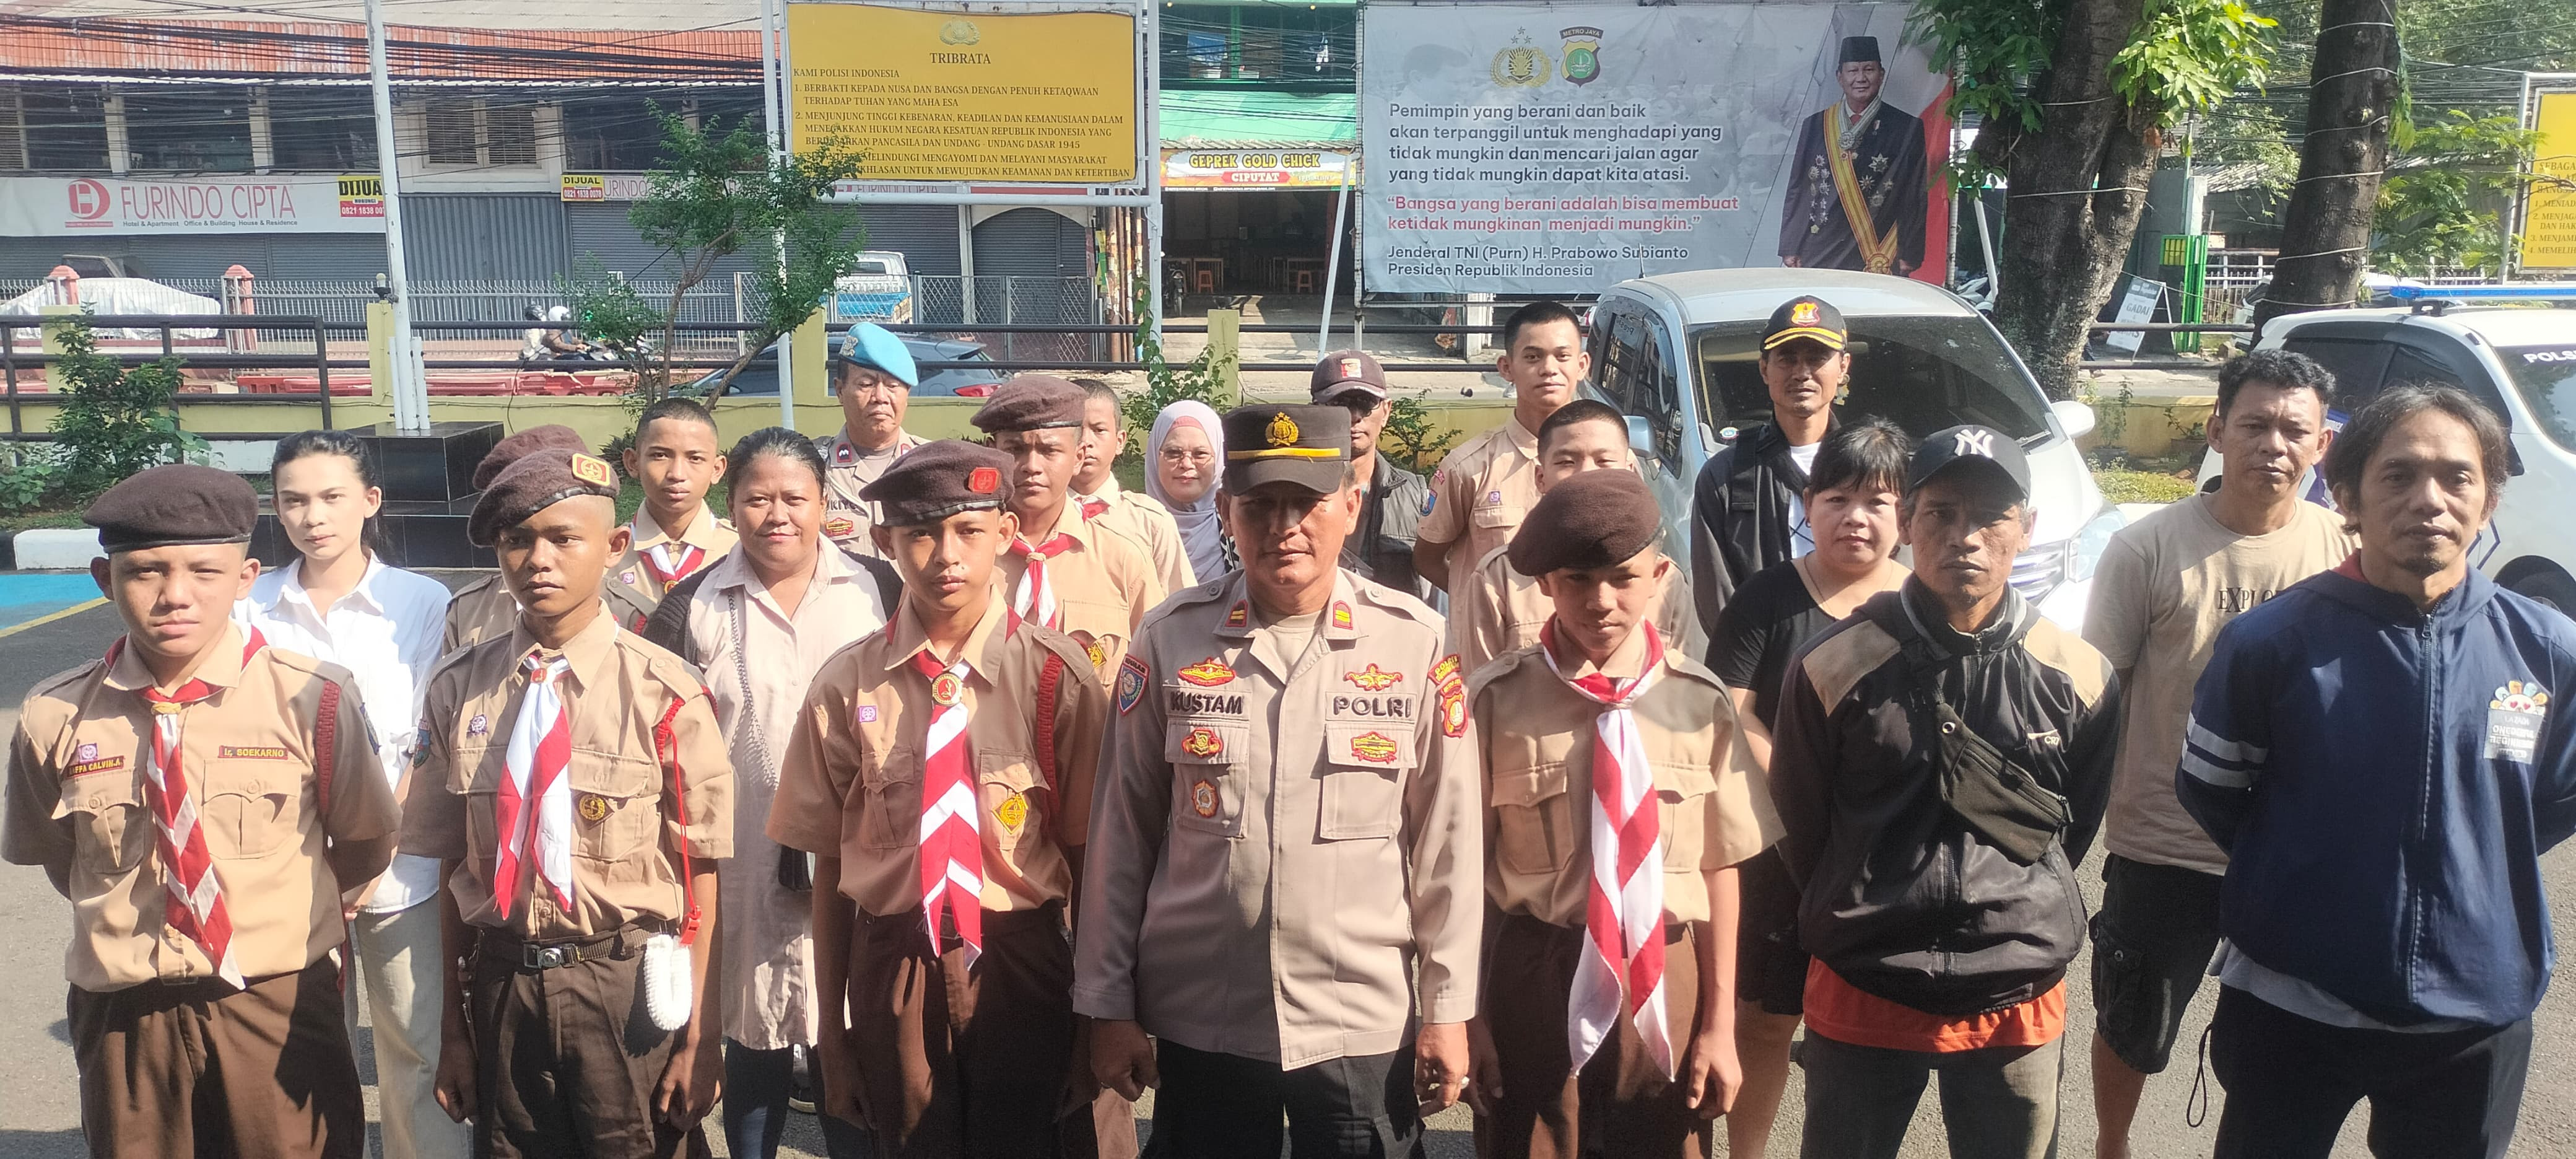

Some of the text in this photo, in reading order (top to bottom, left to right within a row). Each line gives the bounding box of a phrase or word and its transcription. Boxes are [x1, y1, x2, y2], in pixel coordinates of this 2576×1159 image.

[930, 52, 991, 64] TRIBRATA
[794, 68, 900, 78] KAMI POLISI INDONESIA
[795, 84, 1099, 98] 1. BERBAKTI KEPADA NUSA DAN BANGSA DENGAN PENUH KETAQWAAN
[804, 97, 959, 107] TERHADAP TUHAN YANG MAHA ESA
[795, 112, 1123, 124] 2. MENJUNJUNG TINGGI KEBENARAN, KEADILAN DAN KEMANUSIAAN DALAM
[1390, 103, 1645, 121] Pemimpin yang berani dan baik
[805, 124, 1112, 136] MENEGAKKAN HUKUM NEGARA KESATUAN REPUBLIK INDONESIA YANG
[1390, 125, 1721, 141] akan terpanggil untuk menghadapi yang
[872, 138, 920, 147] PANCASILA
[922, 138, 941, 147] DAN
[944, 139, 981, 147] UNDANG
[987, 139, 1024, 149] UNDANG
[1027, 140, 1055, 149] DASAR
[1058, 140, 1080, 149] 1945
[864, 152, 920, 162] MELINDUNGI
[921, 153, 978, 162] MENGAYOMI
[980, 154, 998, 162] DAN
[1000, 154, 1045, 164] MELAYANI
[1048, 155, 1107, 164] MASYARAKAT
[1190, 154, 1321, 168] GEPREK GOLD CHICK
[1390, 146, 1699, 163] tidak mungkin dan mencari jalan agar
[903, 166, 934, 175] UNTUK
[936, 166, 999, 177] MEWUJUDKAN
[1002, 167, 1051, 177] KEAMANAN
[1054, 168, 1073, 177] DAN
[1074, 168, 1129, 177] KETERTIBAN
[1231, 173, 1280, 182] CIPUTAT
[1389, 167, 1689, 183] yang tidak mungkin dapat kita atasi.
[339, 181, 382, 196] DIJUA
[564, 190, 575, 198] 0821
[604, 180, 648, 197] URINDO
[121, 185, 296, 220] FURINDO CIPTA
[1460, 199, 1500, 213] yang
[1504, 196, 1557, 211] berani
[1561, 196, 1618, 211] adalah
[1622, 196, 1656, 211] bisa
[1661, 197, 1739, 211] membuat
[1388, 216, 1449, 230] ketidak
[1453, 216, 1541, 233] mungkinan
[1549, 216, 1614, 233] menjadi
[1388, 245, 1688, 261] Jenderal TNI (Purn) H. Prabowo Subianto
[1388, 263, 1593, 278] Presiden Republik Indonesia
[2126, 303, 2150, 315] GADAI
[2523, 350, 2576, 363] POLS
[1954, 429, 1994, 458] NY
[2217, 586, 2283, 612] EXPLO
[1170, 691, 1243, 714] KUSTAM
[1333, 696, 1411, 717] POLRI
[2044, 736, 2060, 745] CR7
